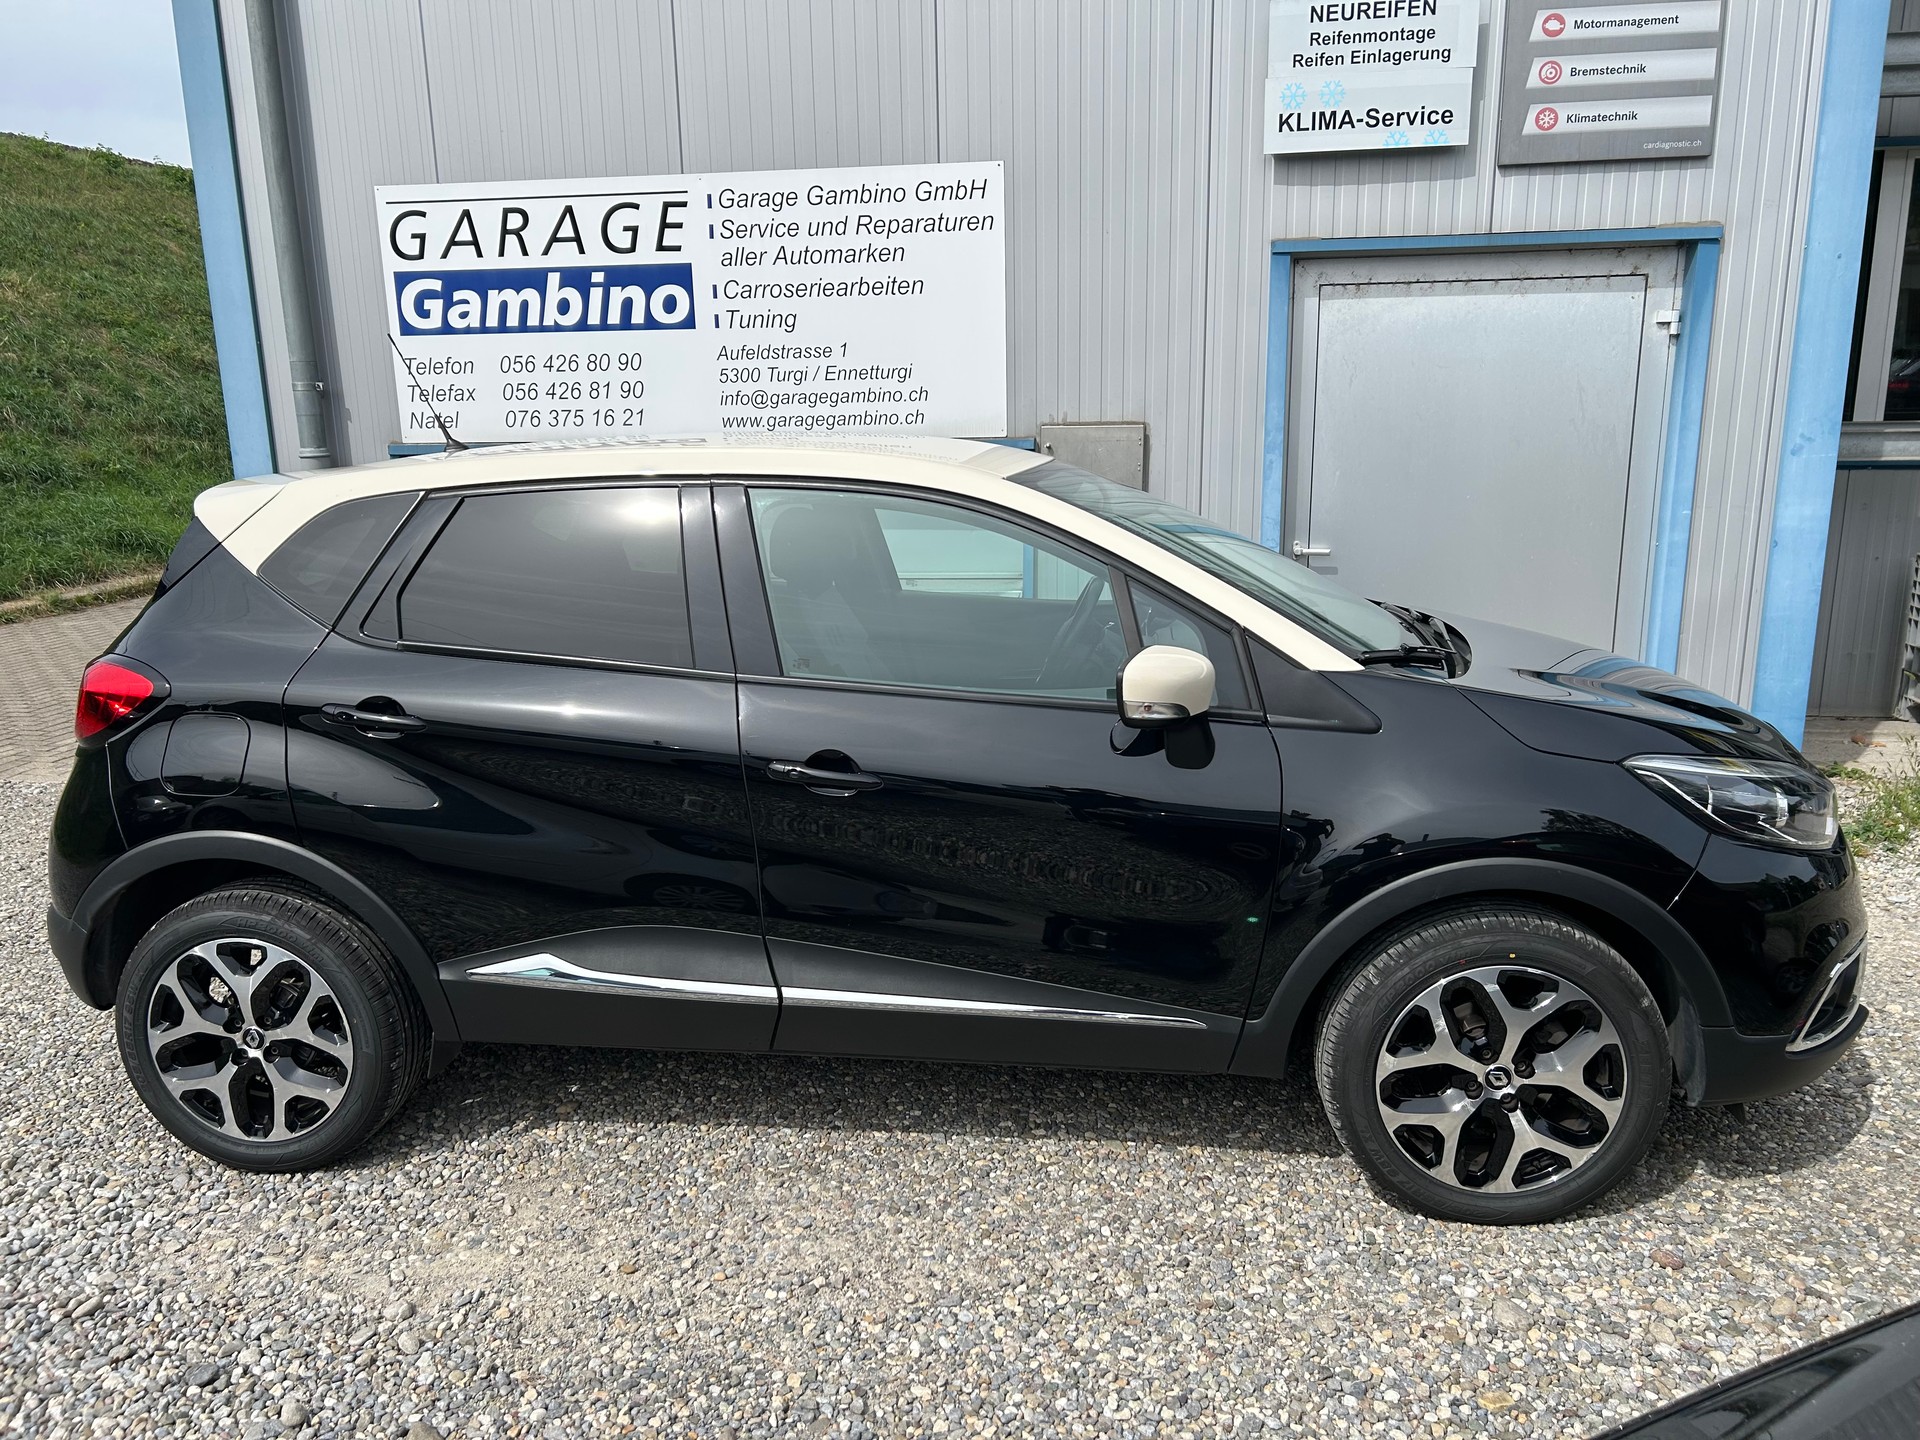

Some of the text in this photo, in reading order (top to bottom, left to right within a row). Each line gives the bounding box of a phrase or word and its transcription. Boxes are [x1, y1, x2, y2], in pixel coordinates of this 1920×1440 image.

[1310, 0, 1437, 24] NEUREIFEN
[1573, 14, 1680, 30] Motormanagement
[1309, 27, 1436, 47] Reifenmontage
[1292, 48, 1452, 68] Reifen Einlagerung
[1570, 63, 1647, 77] Bremstechnik
[1278, 105, 1454, 133] KLIMA-Service
[1566, 110, 1638, 124] Klimatechnik
[1643, 139, 1702, 150] cardiagnostic.ch
[718, 178, 988, 213] Garage Gambino GmbH
[389, 200, 689, 261] GARAGE
[720, 212, 994, 240] Service und Reparaturen
[720, 242, 905, 267] aller Automarken
[723, 275, 924, 300] Carroseriearbeiten
[400, 271, 690, 330] Gambino
[725, 308, 797, 334] Tuning
[716, 342, 847, 361] Aufeldstrasse 1
[404, 352, 642, 376] Telefon 056 426 80 90
[719, 367, 761, 384] 5300
[767, 366, 808, 386] Turgi
[824, 363, 913, 387] Ennetturgi
[407, 380, 644, 402] Telefax 056 426 81 90
[720, 385, 929, 410] info@garagegambino.ch
[505, 409, 541, 428] 076
[548, 409, 584, 428] 375
[592, 408, 615, 427] 16
[622, 408, 644, 427] 21
[721, 409, 925, 432] www.garagegambino.ch
